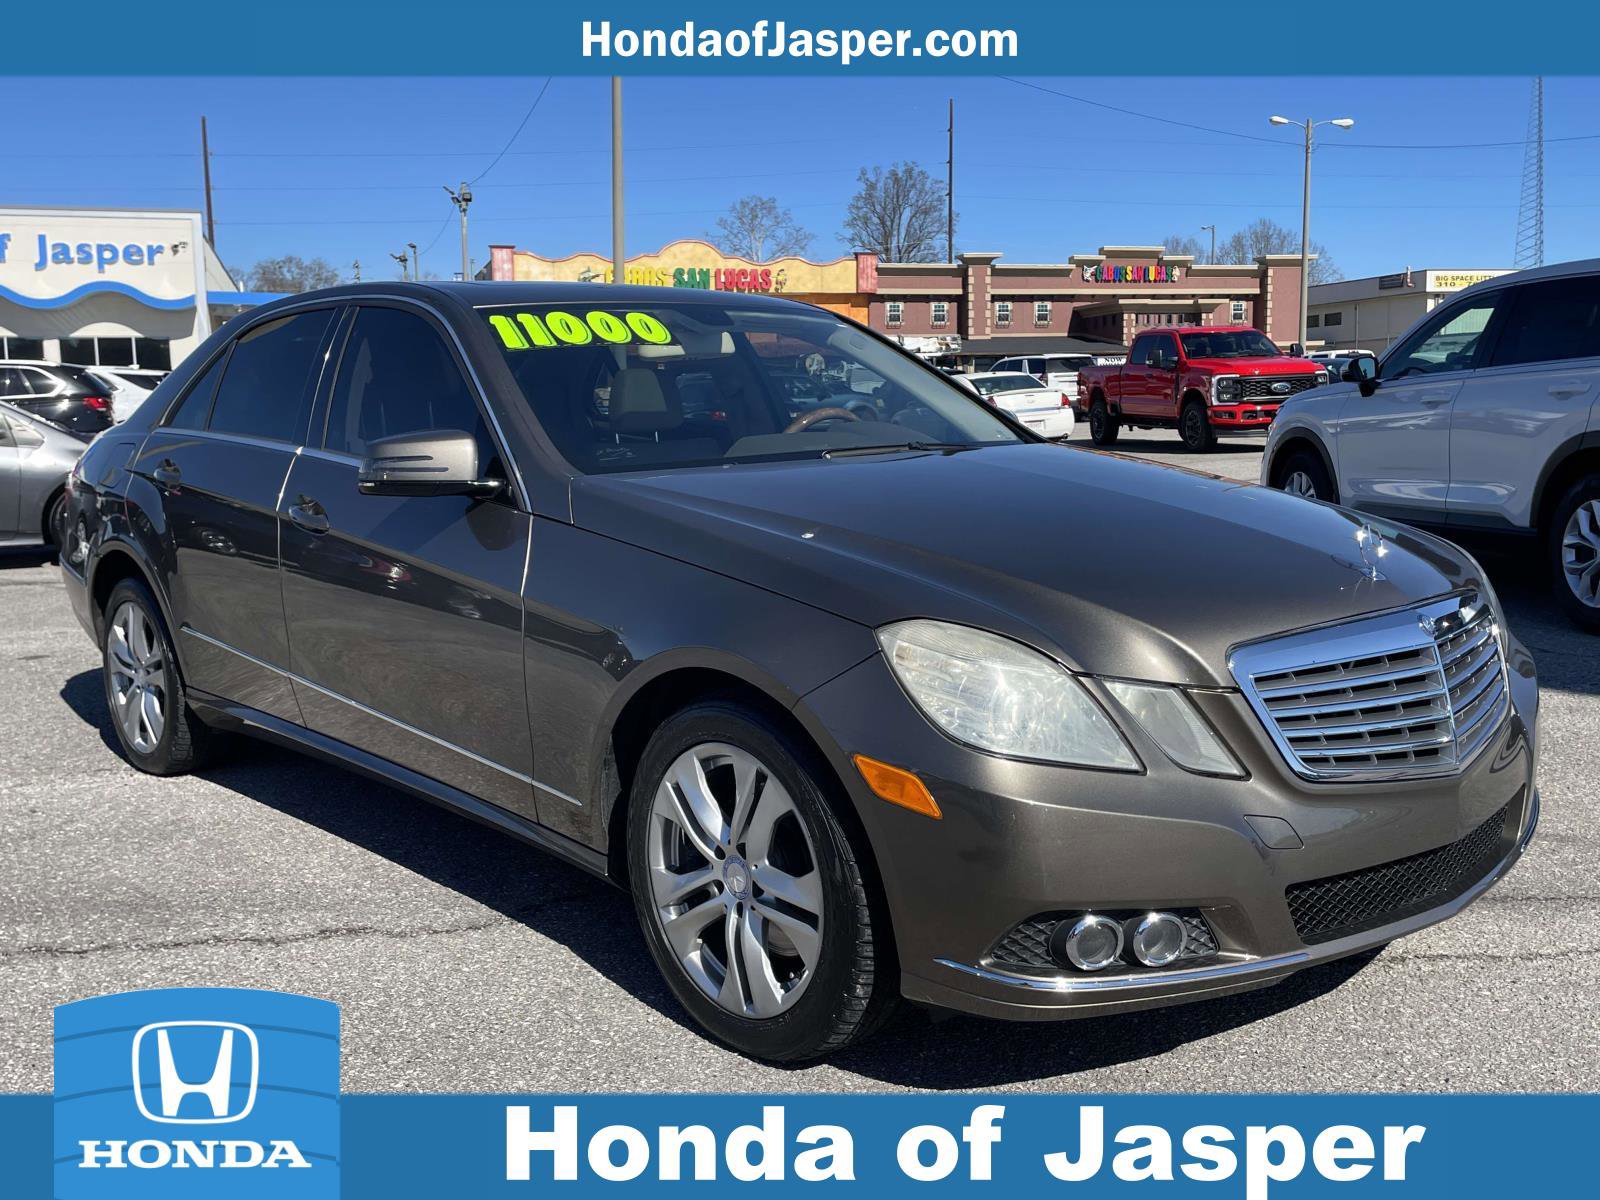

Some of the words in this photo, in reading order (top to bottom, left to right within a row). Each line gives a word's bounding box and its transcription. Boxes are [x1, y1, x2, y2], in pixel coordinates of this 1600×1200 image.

[34, 234, 164, 273] Jasper
[672, 267, 710, 289] SAN
[714, 268, 773, 292] LUCAS
[1096, 265, 1125, 281] CABOS
[1126, 265, 1143, 282] SAN
[1144, 265, 1172, 282] LUCAS
[489, 311, 672, 349] 11000
